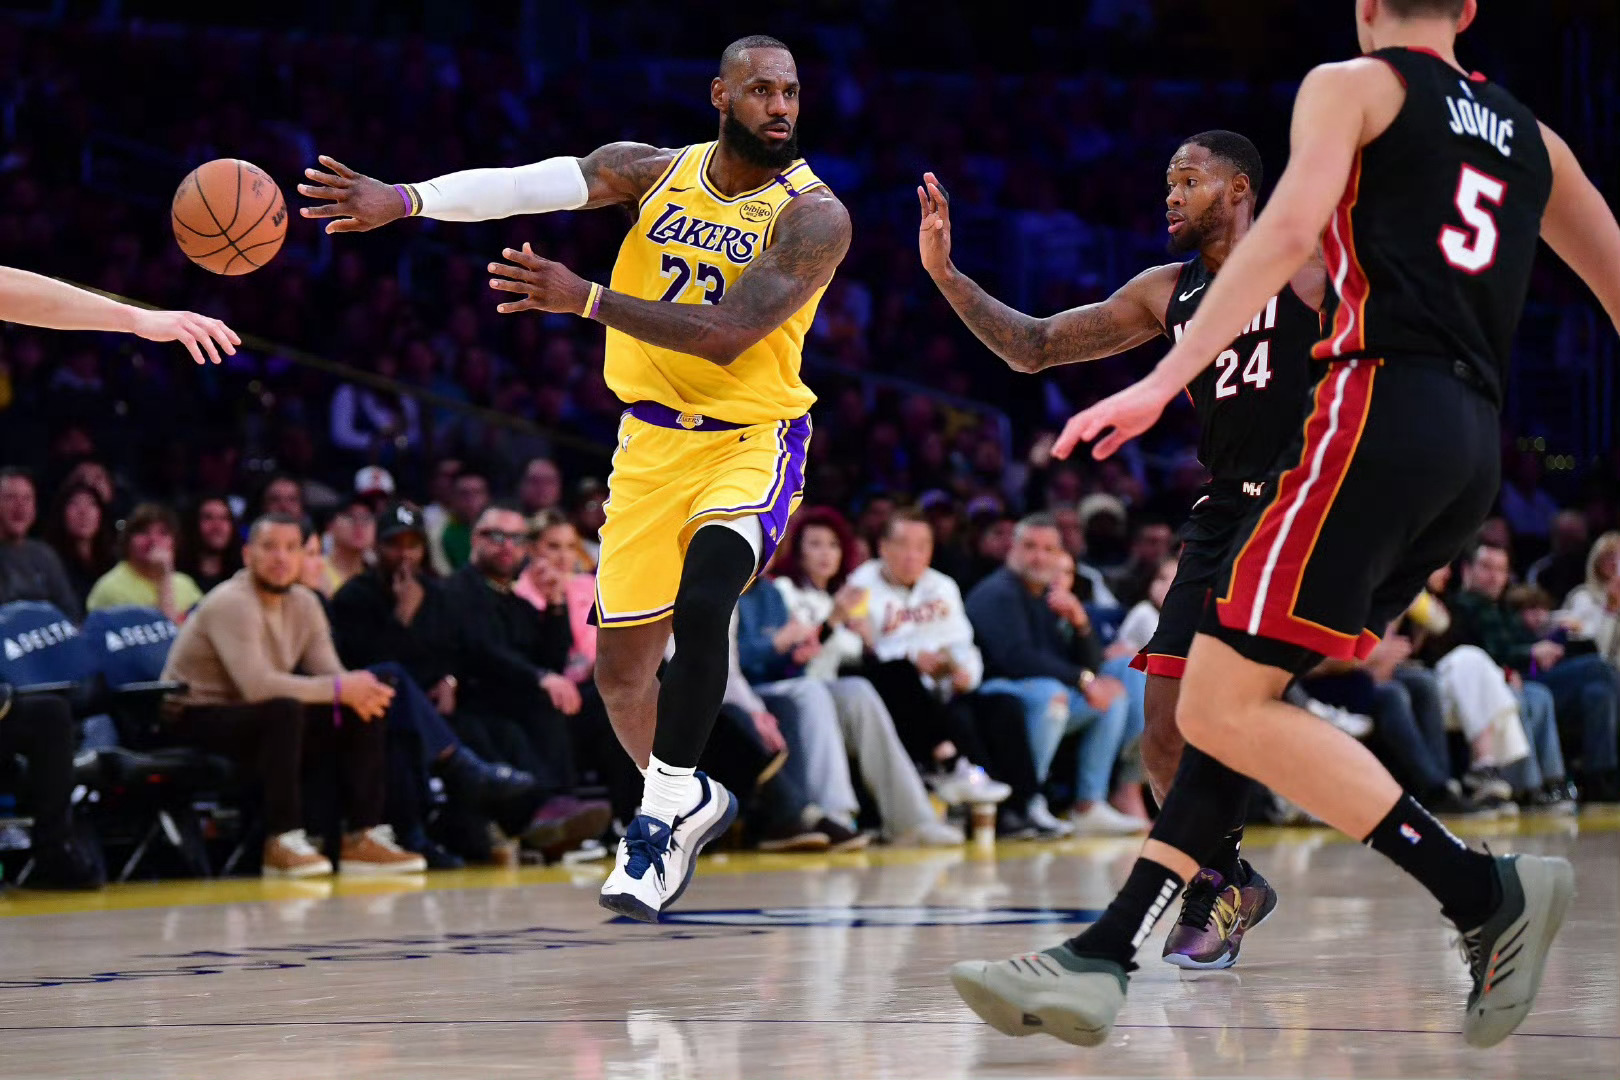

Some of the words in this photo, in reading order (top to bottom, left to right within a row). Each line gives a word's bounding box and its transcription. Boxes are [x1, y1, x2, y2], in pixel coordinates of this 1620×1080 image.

[646, 202, 760, 266] LAKERS
[743, 204, 771, 217] bibigo
[1437, 162, 1508, 276] 5
[660, 252, 726, 305] 23
[1215, 340, 1272, 399] 24
[17, 619, 79, 653] DELTA
